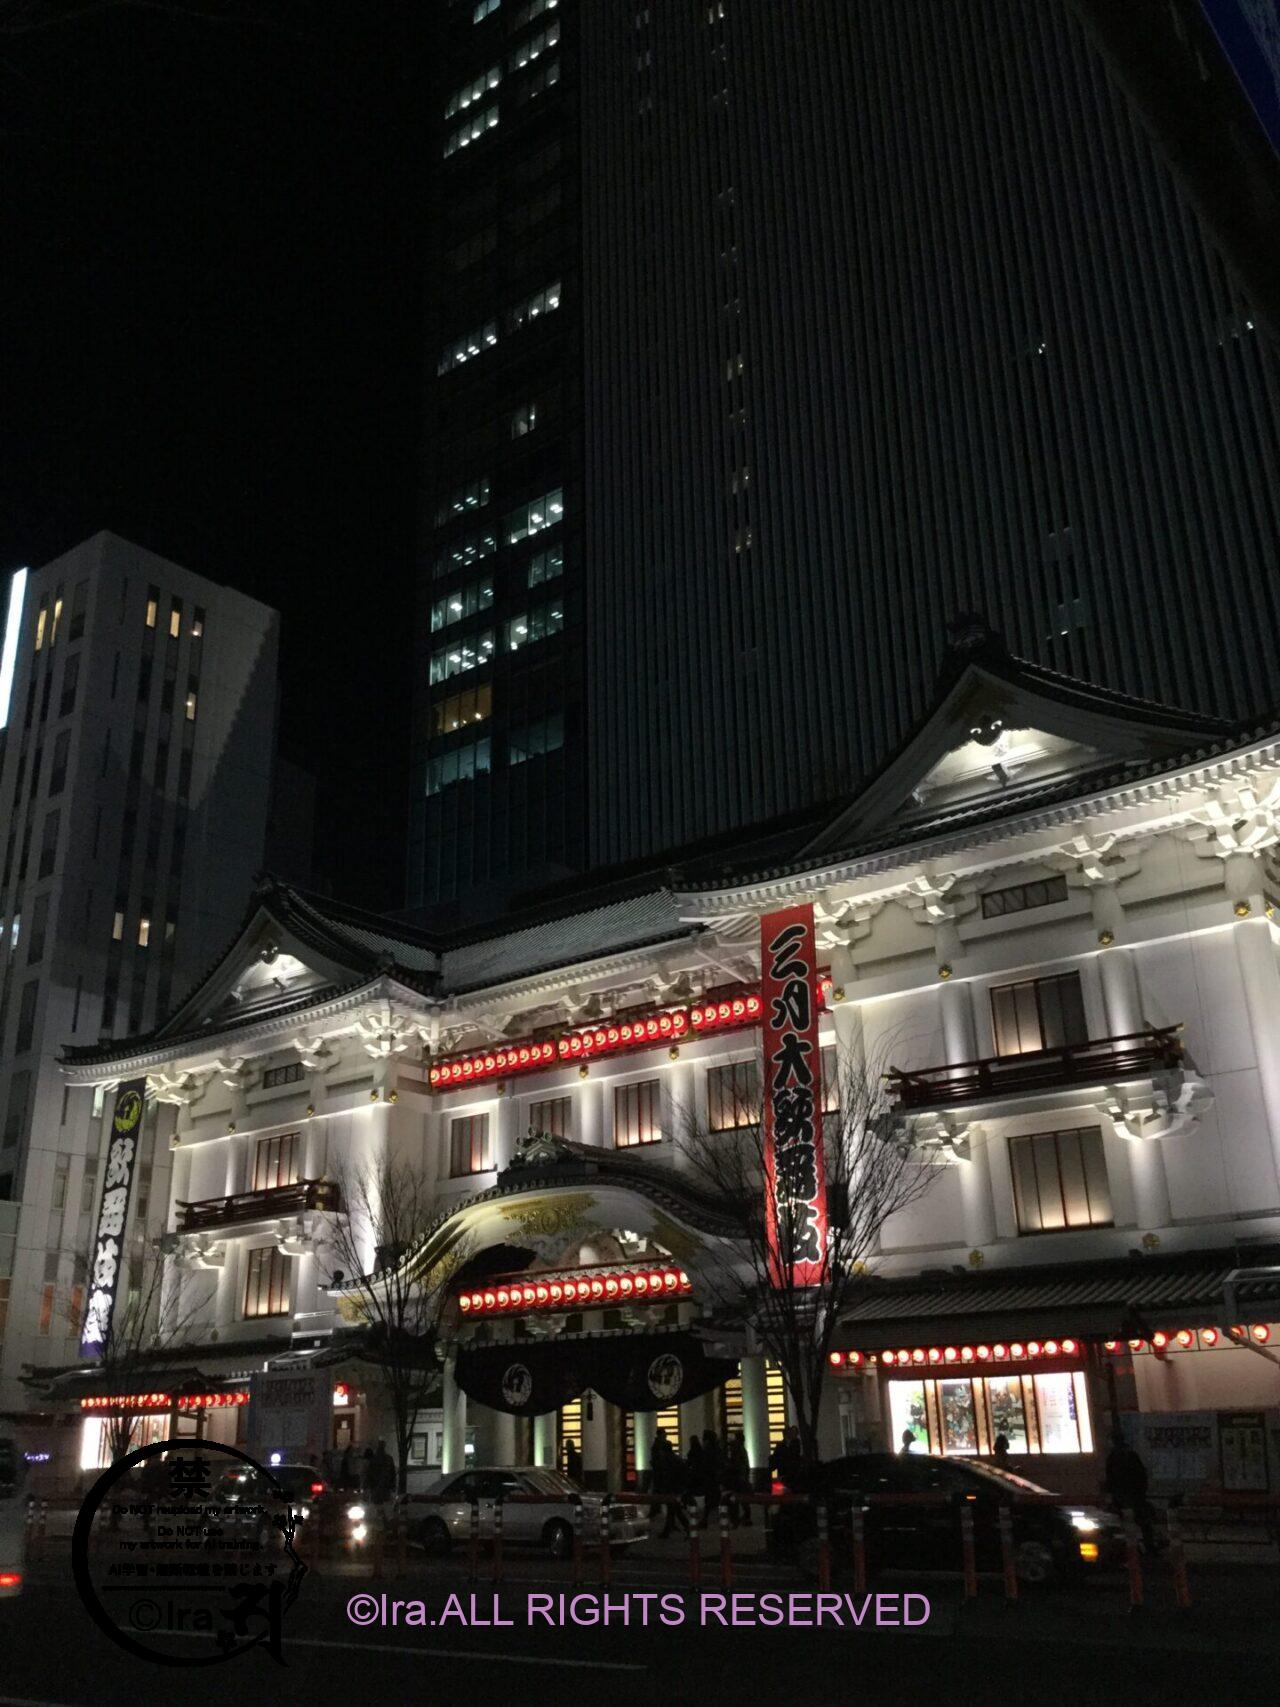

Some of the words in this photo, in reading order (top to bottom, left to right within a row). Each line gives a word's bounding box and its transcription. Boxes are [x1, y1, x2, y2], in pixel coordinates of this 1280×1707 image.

[769, 924, 822, 1264] 三月大歌舞伎
[82, 1138, 134, 1344] 歌舞伎座
